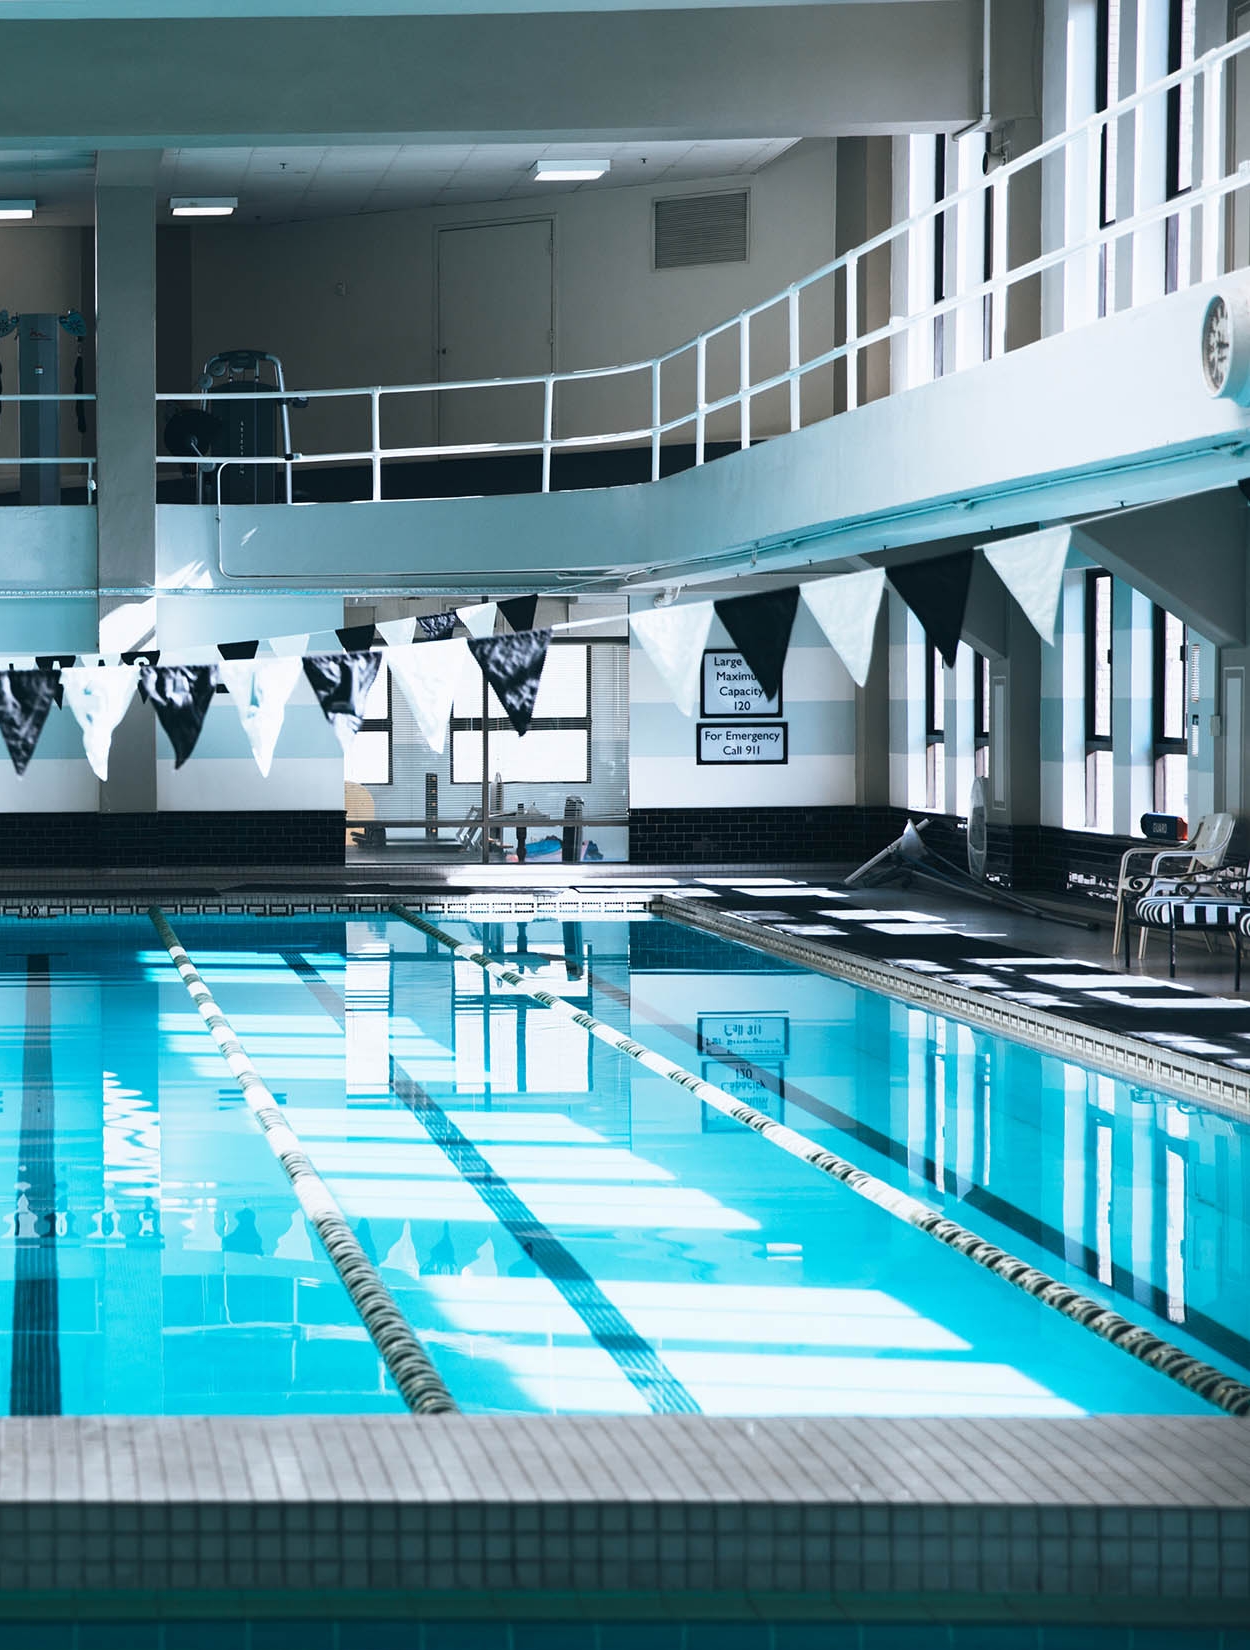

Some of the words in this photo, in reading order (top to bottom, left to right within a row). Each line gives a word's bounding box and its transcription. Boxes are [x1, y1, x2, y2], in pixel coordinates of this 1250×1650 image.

[714, 656, 742, 668] Large
[716, 672, 757, 681] Maximu
[719, 686, 764, 698] Capacity
[734, 701, 751, 711] 120
[705, 731, 722, 741] For
[726, 731, 780, 743] Emergency
[723, 745, 742, 755] Call
[745, 745, 760, 755] 911
